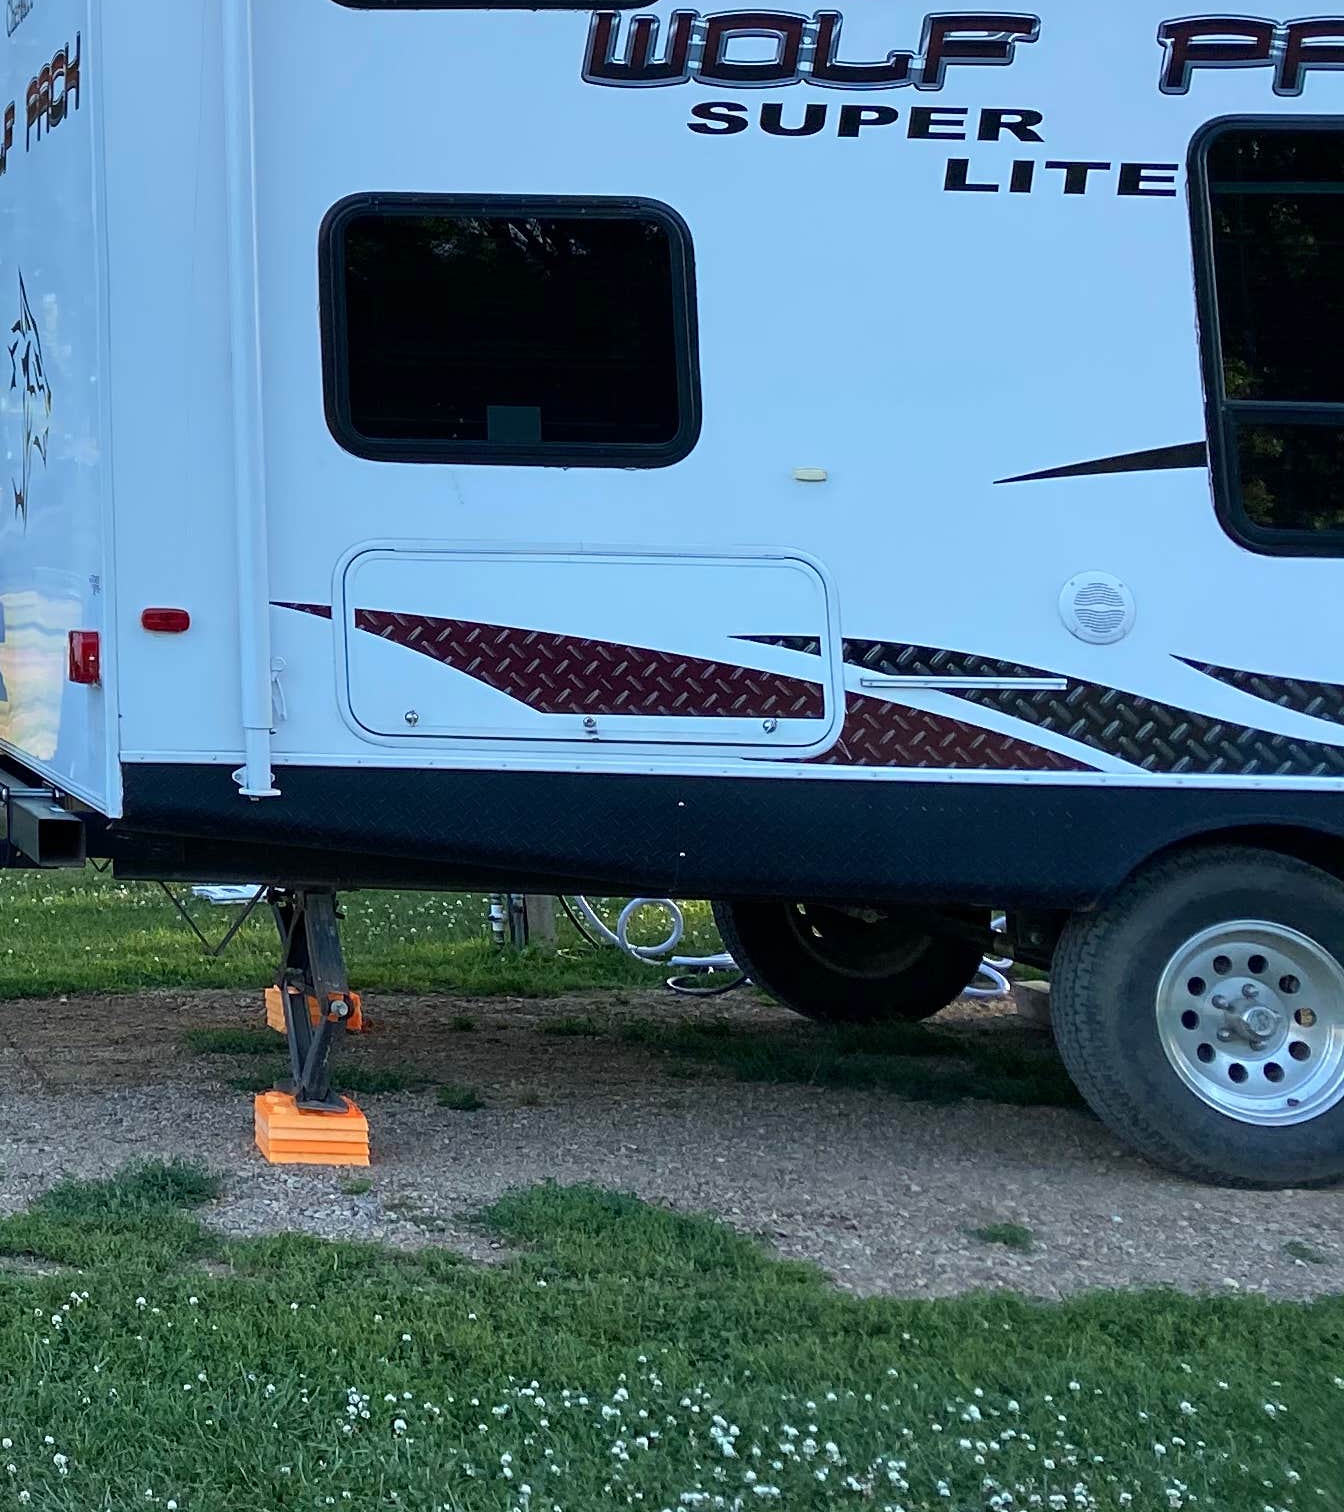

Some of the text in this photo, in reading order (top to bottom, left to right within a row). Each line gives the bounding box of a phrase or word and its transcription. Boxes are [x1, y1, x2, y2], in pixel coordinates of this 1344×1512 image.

[581, 9, 1041, 90] WOLF
[687, 101, 1046, 143] SUPER
[943, 157, 1179, 197] LITE
